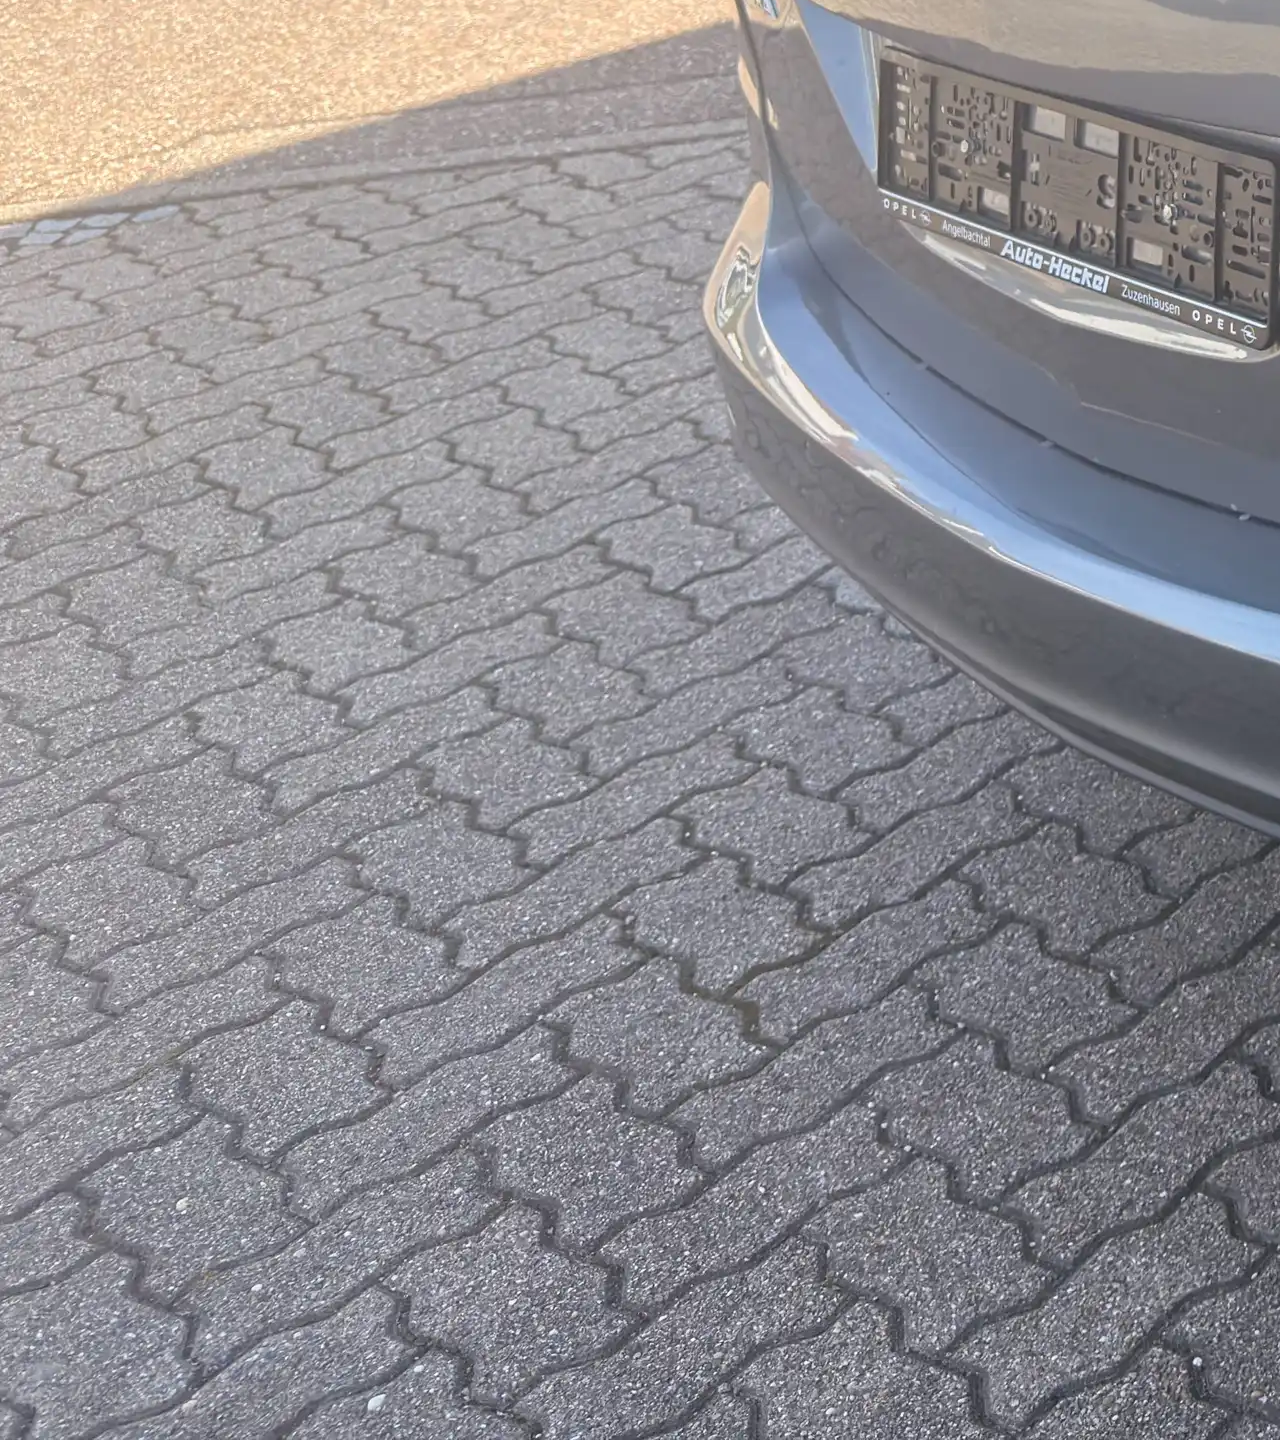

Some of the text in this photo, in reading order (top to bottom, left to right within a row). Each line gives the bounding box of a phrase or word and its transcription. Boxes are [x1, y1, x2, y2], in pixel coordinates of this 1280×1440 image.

[882, 197, 1237, 335] OPEL Angelbachtal Auto-Heckel Zuzenhausen OPEL
